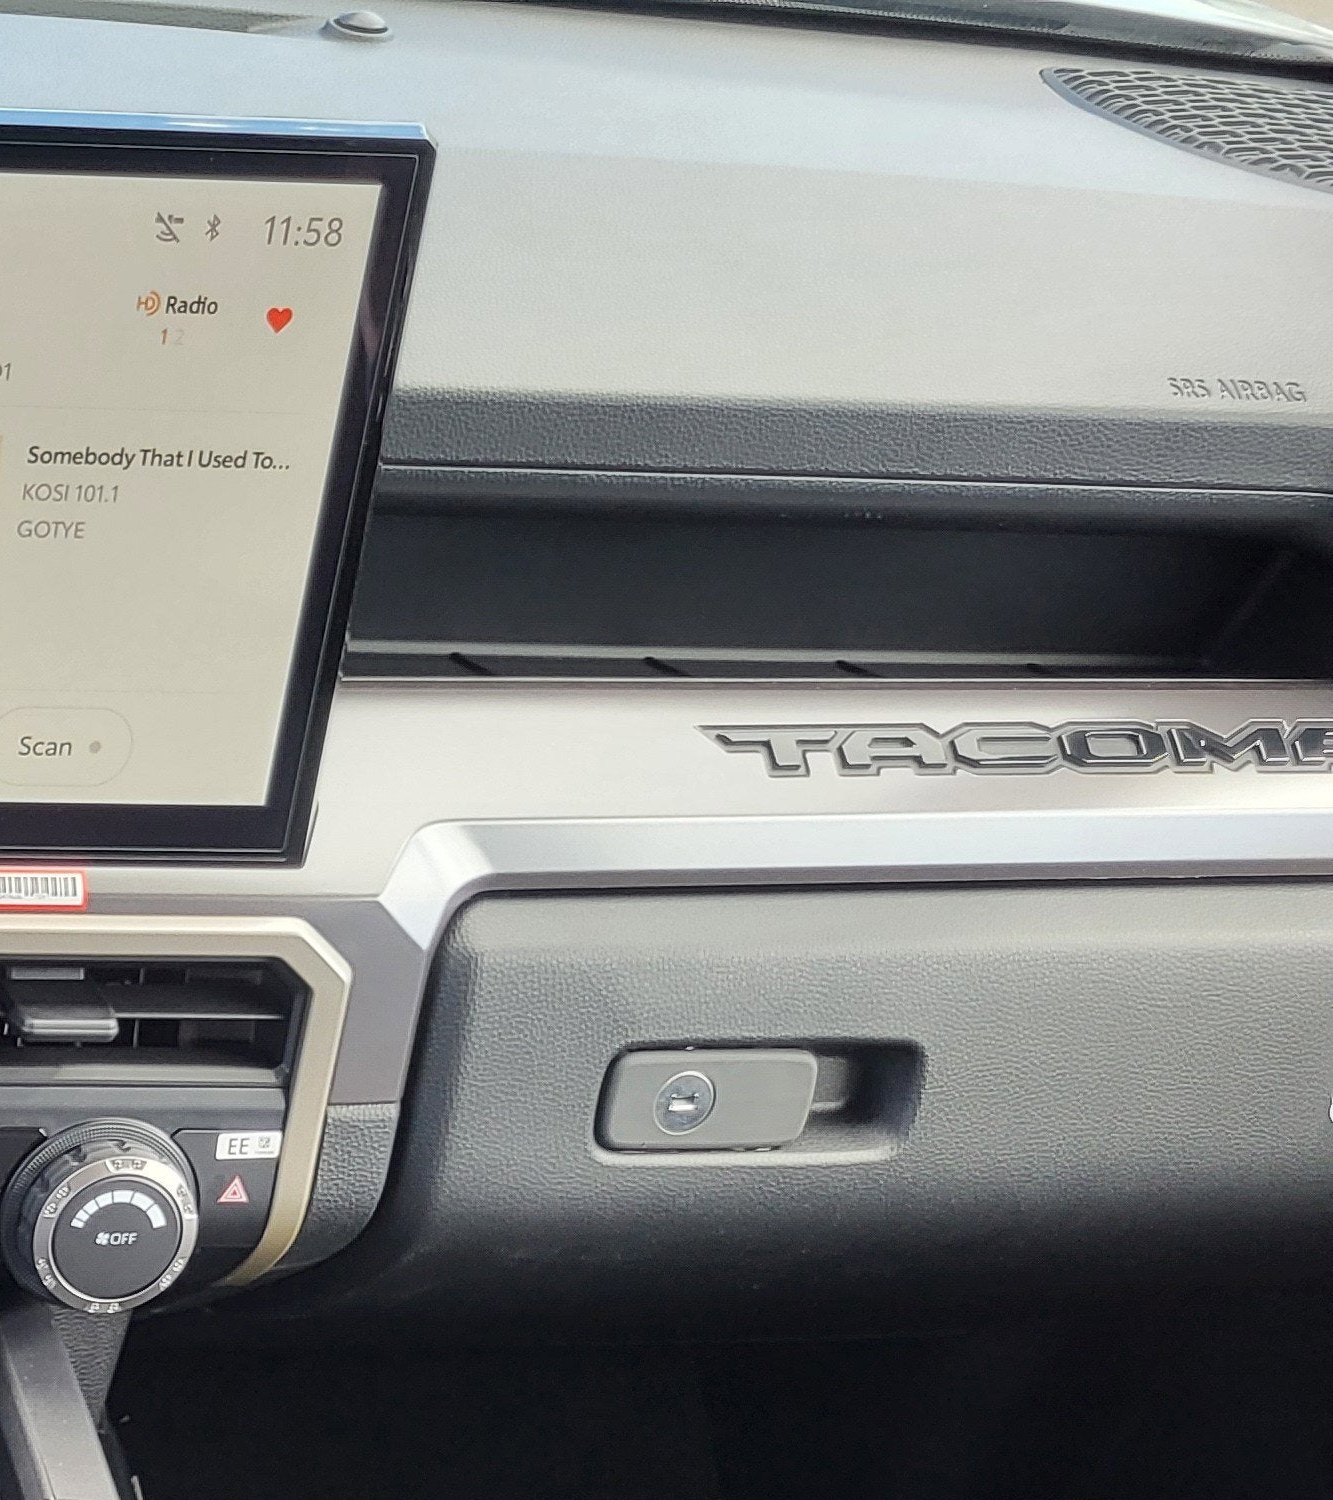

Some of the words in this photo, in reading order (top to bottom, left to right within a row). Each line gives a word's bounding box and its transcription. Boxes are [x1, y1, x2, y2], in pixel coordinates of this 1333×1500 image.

[264, 215, 343, 248] 11:58
[165, 294, 218, 315] Radio
[1167, 377, 1211, 398] SRS
[1217, 378, 1307, 402] AIRBAG
[27, 446, 135, 470] Somebody
[140, 448, 183, 467] That
[187, 450, 193, 467] I
[197, 450, 247, 468] Used
[251, 451, 290, 470] To...
[22, 483, 69, 502] KOSI
[75, 484, 119, 503] 101.1
[17, 520, 86, 540] GOTYE
[17, 736, 72, 757] Scan
[227, 1137, 251, 1156] EE
[110, 1232, 138, 1246] OFF
